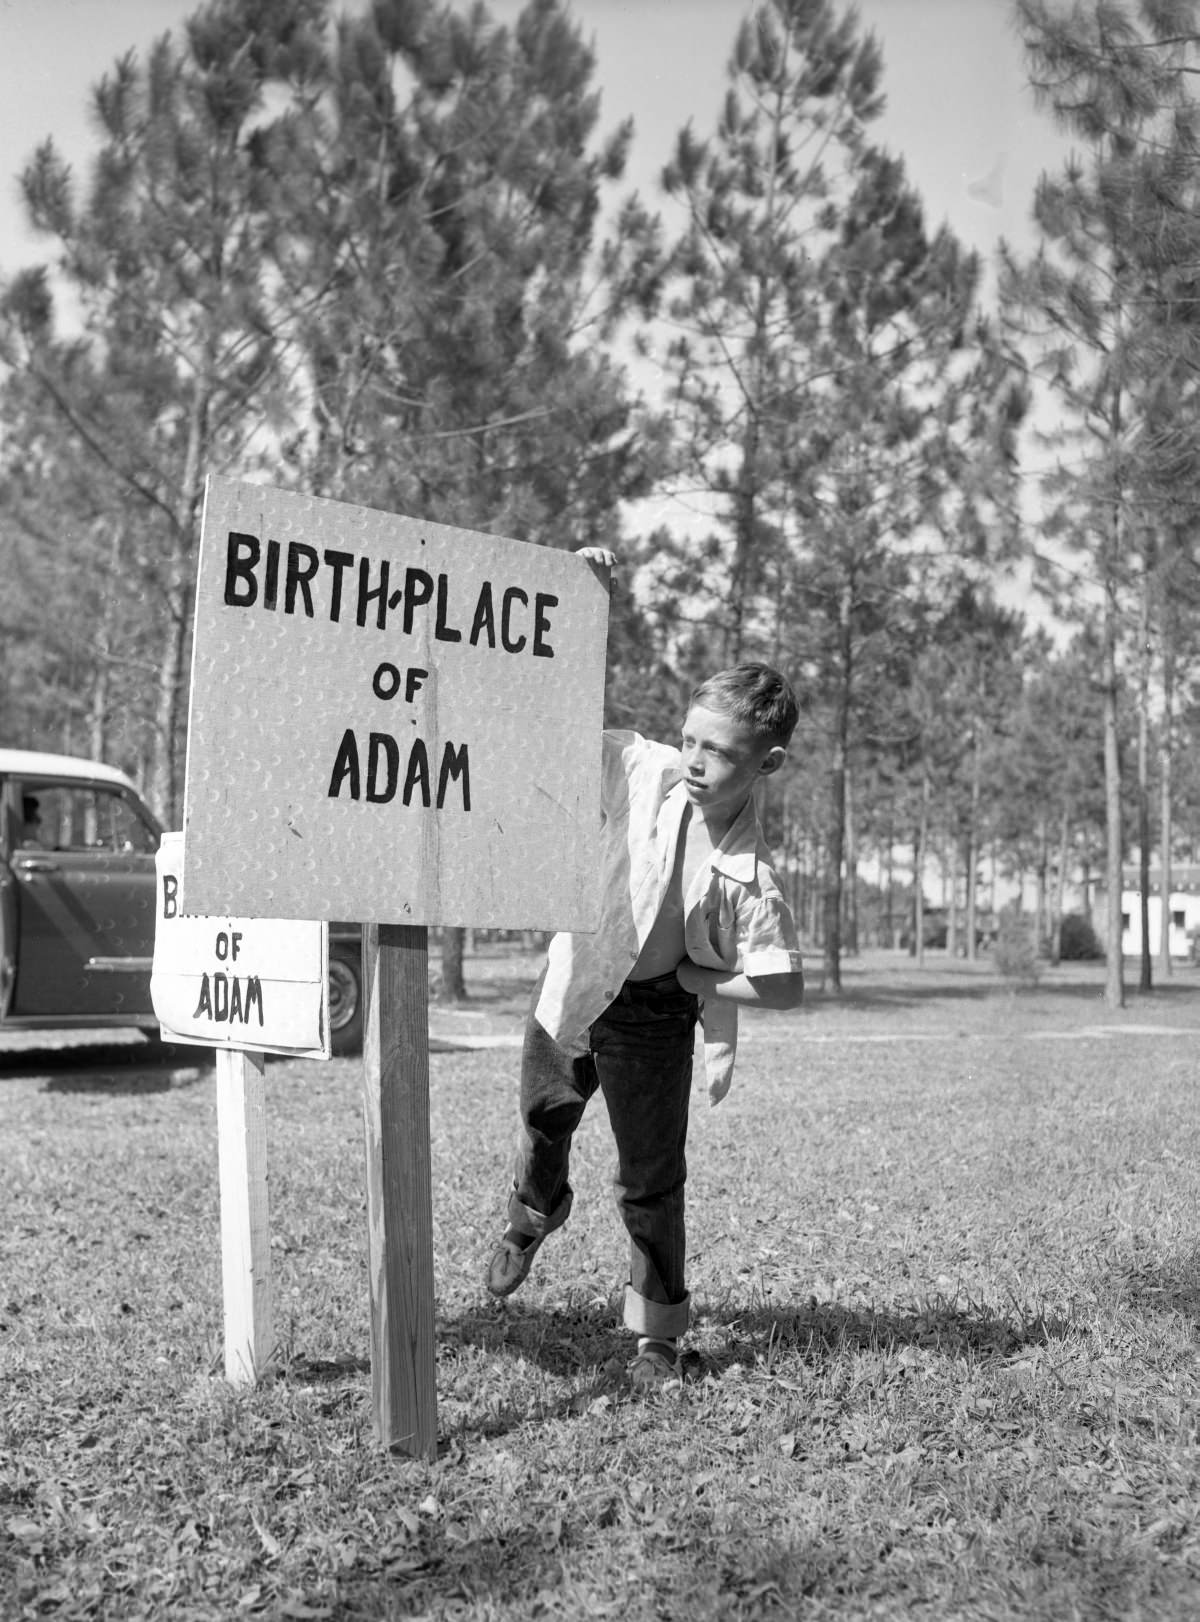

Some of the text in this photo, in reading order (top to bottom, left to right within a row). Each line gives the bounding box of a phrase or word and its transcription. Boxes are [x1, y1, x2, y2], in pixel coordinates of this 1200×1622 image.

[372, 662, 429, 703] OF
[327, 728, 471, 812] ADAM
[215, 932, 243, 961] OF
[192, 972, 264, 1027] ADAM
